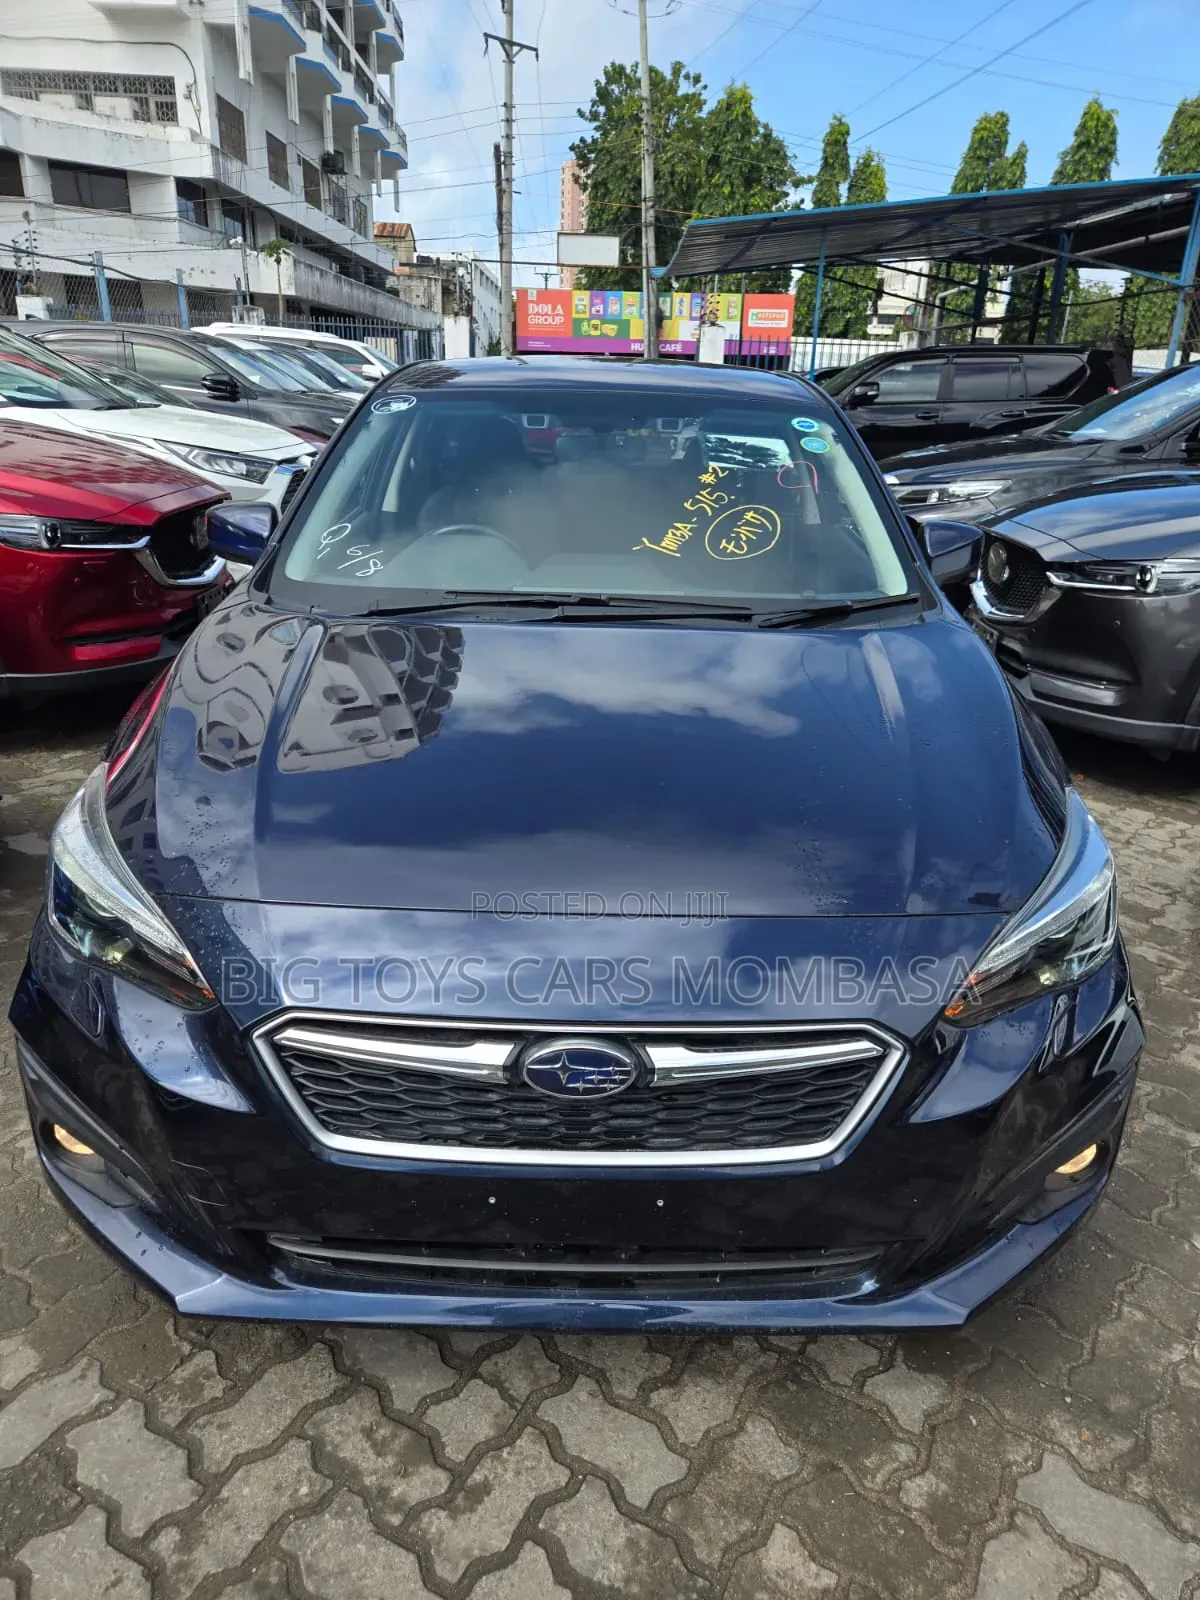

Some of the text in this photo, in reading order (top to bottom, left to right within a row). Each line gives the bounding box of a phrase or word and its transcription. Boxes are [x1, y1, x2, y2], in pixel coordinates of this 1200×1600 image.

[528, 303, 564, 314] DOLA
[528, 315, 565, 325] GROUP
[659, 342, 683, 352] CAFÉ
